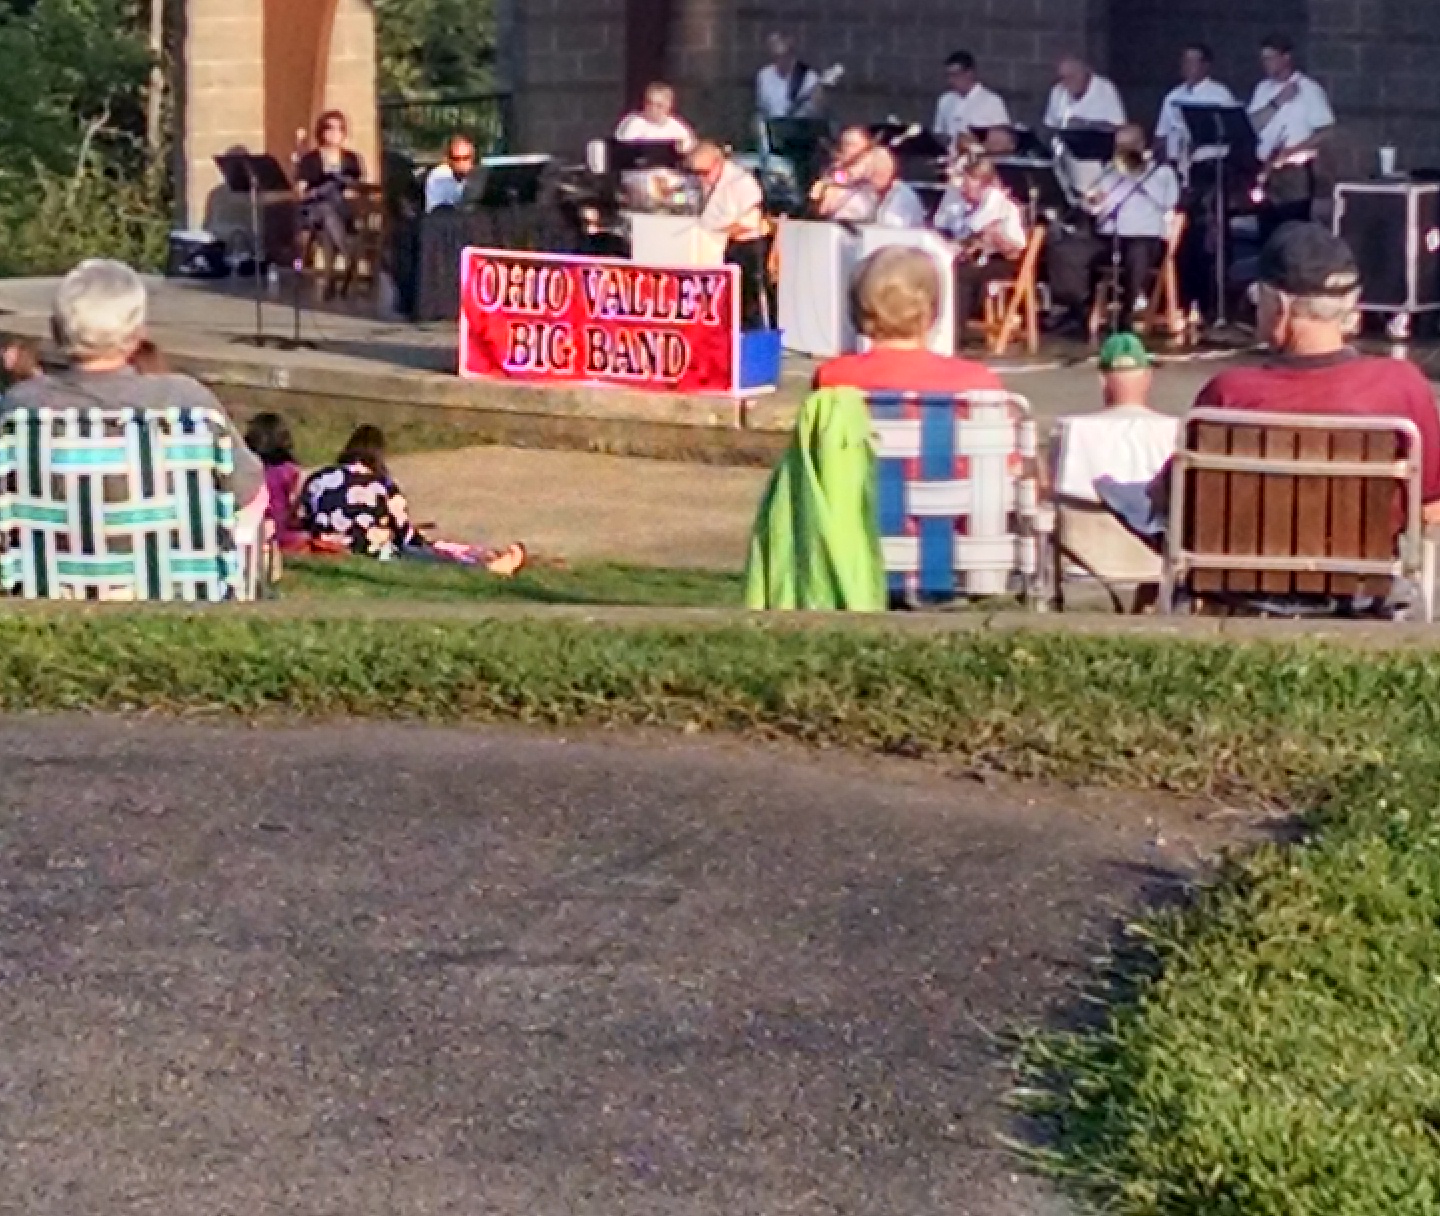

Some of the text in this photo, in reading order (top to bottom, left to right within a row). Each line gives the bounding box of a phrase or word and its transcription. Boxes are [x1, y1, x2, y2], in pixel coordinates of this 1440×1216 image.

[473, 262, 724, 324] OHIO VALLEY
[504, 322, 690, 381] BIG BAND
